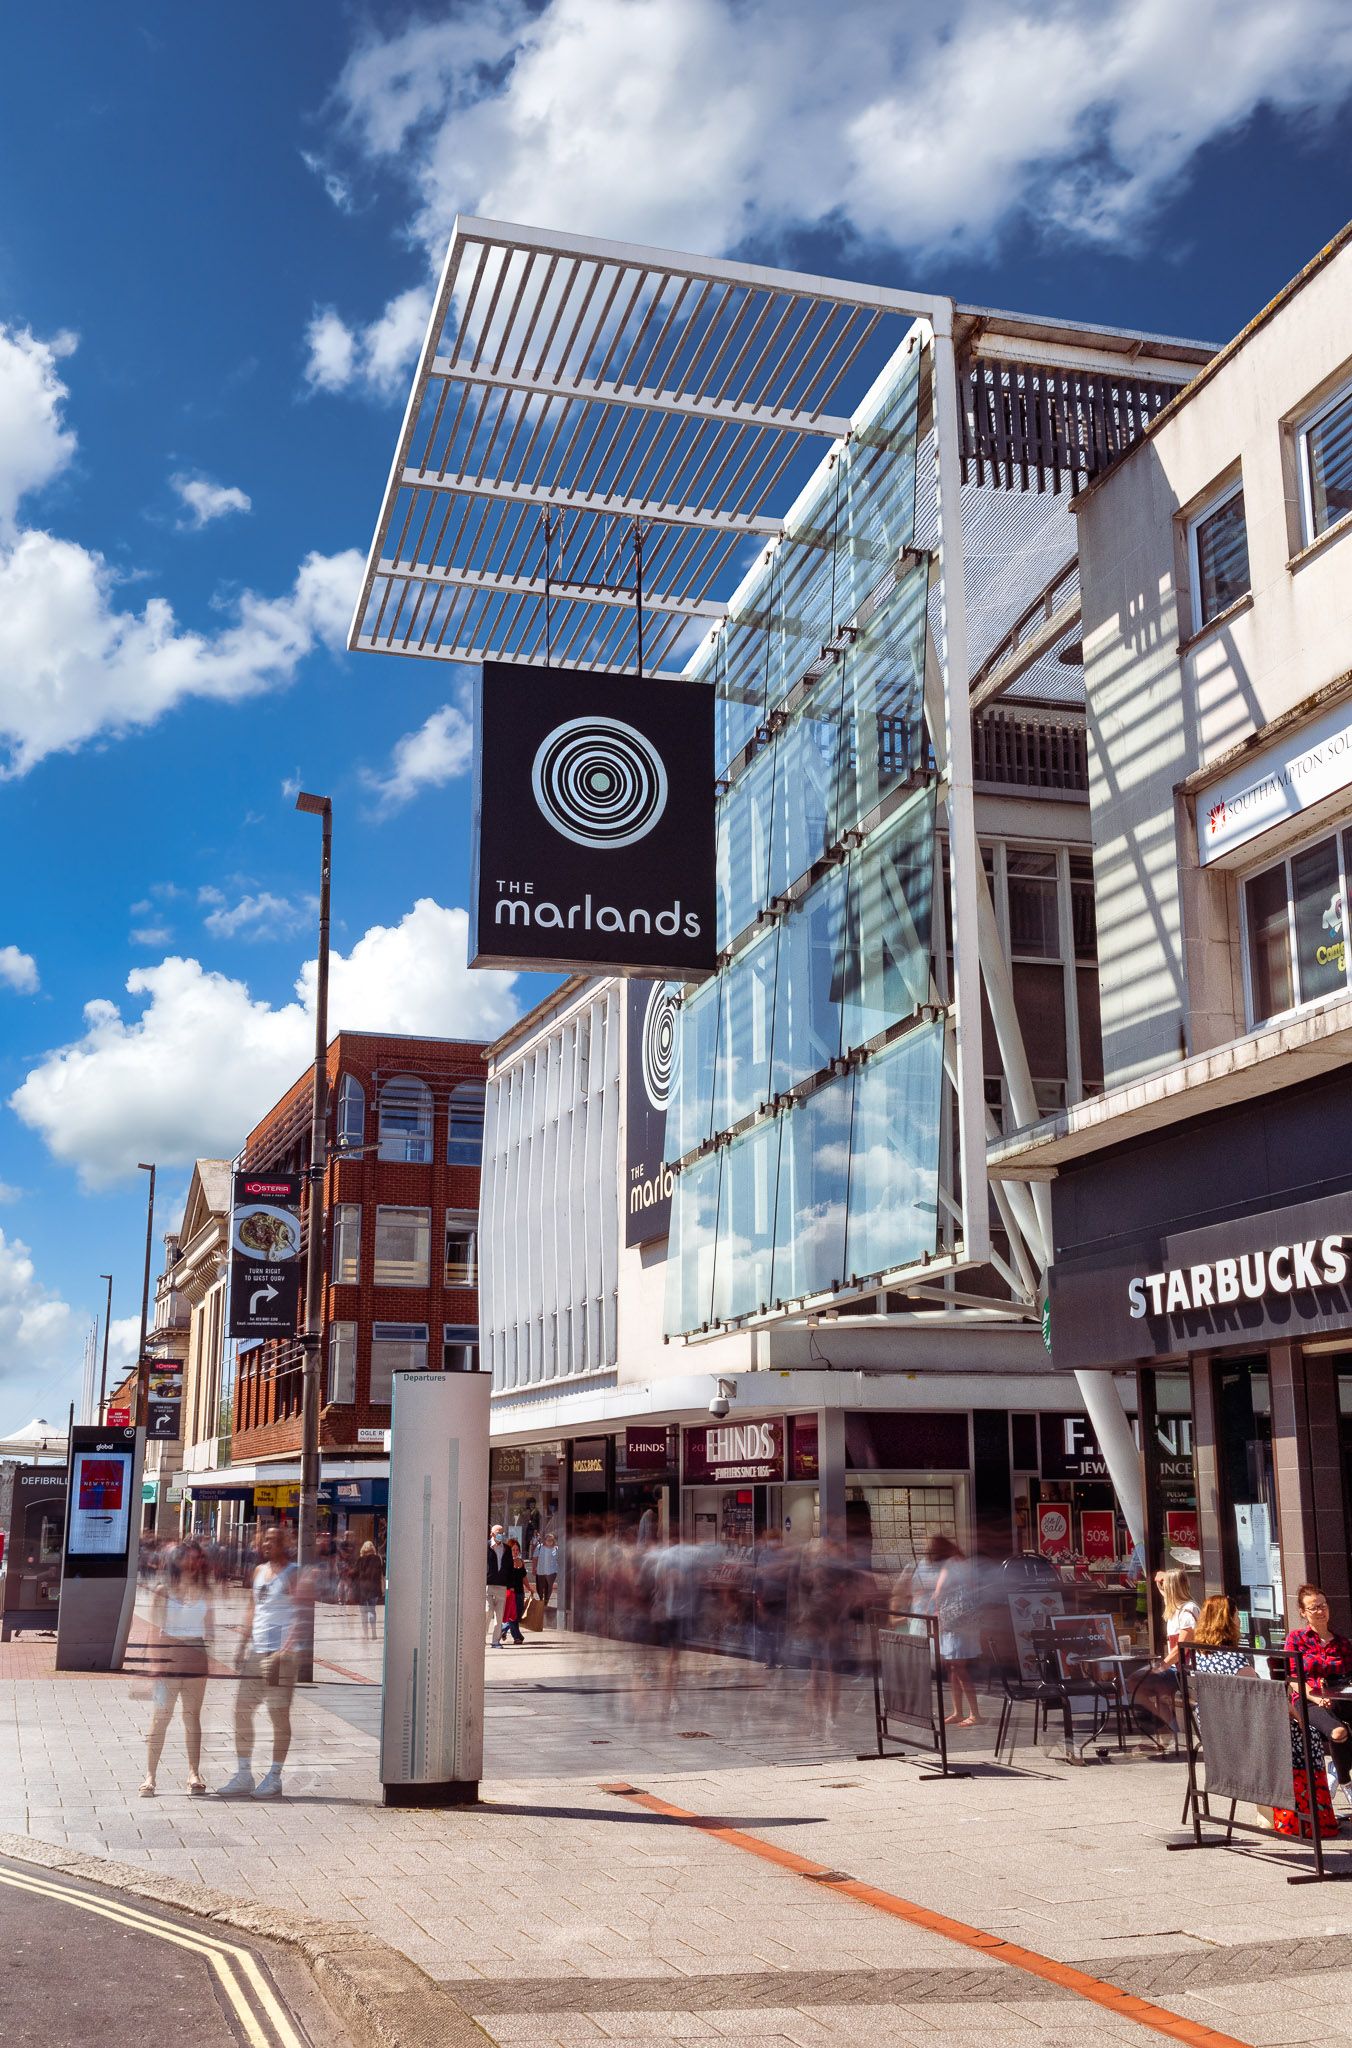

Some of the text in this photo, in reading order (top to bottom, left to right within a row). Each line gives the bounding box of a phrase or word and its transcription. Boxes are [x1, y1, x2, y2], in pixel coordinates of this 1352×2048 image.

[1228, 749, 1323, 816] SOUTHAMPTON
[496, 880, 534, 895] THE
[495, 893, 701, 938] marlands
[631, 1163, 644, 1181] THE
[247, 1183, 289, 1193] L'OSTERIA
[1128, 1235, 1347, 1319] STARBUCKS
[403, 1374, 446, 1382] Departures
[629, 1443, 665, 1452] F.HINDS
[1086, 1530, 1109, 1542] 50%
[1173, 1530, 1196, 1542] 50%
